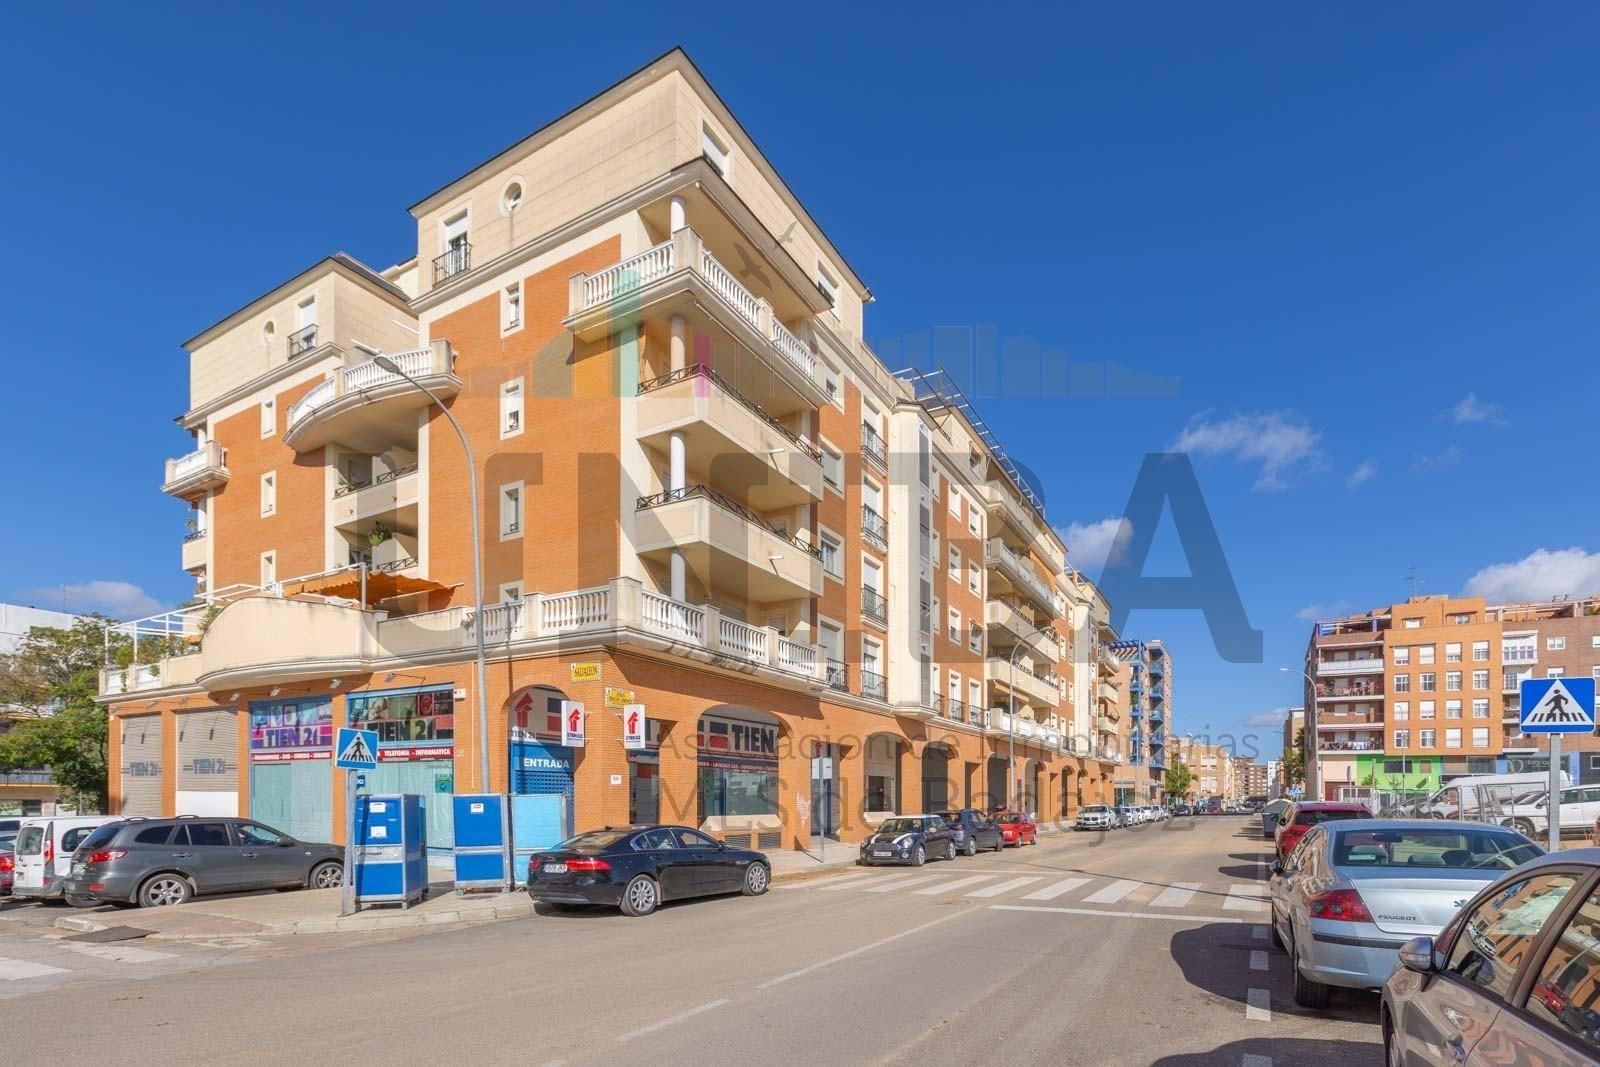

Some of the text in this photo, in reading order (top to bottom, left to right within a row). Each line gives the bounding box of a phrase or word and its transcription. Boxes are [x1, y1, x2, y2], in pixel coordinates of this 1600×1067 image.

[265, 727, 318, 748] TIEN 21
[415, 719, 434, 740] 21
[731, 724, 774, 753] TIEN
[383, 749, 410, 757] TELEFONIA
[415, 748, 451, 756] INFORMATICA
[193, 759, 215, 775] TIEN
[523, 758, 570, 768] ENTRADA
